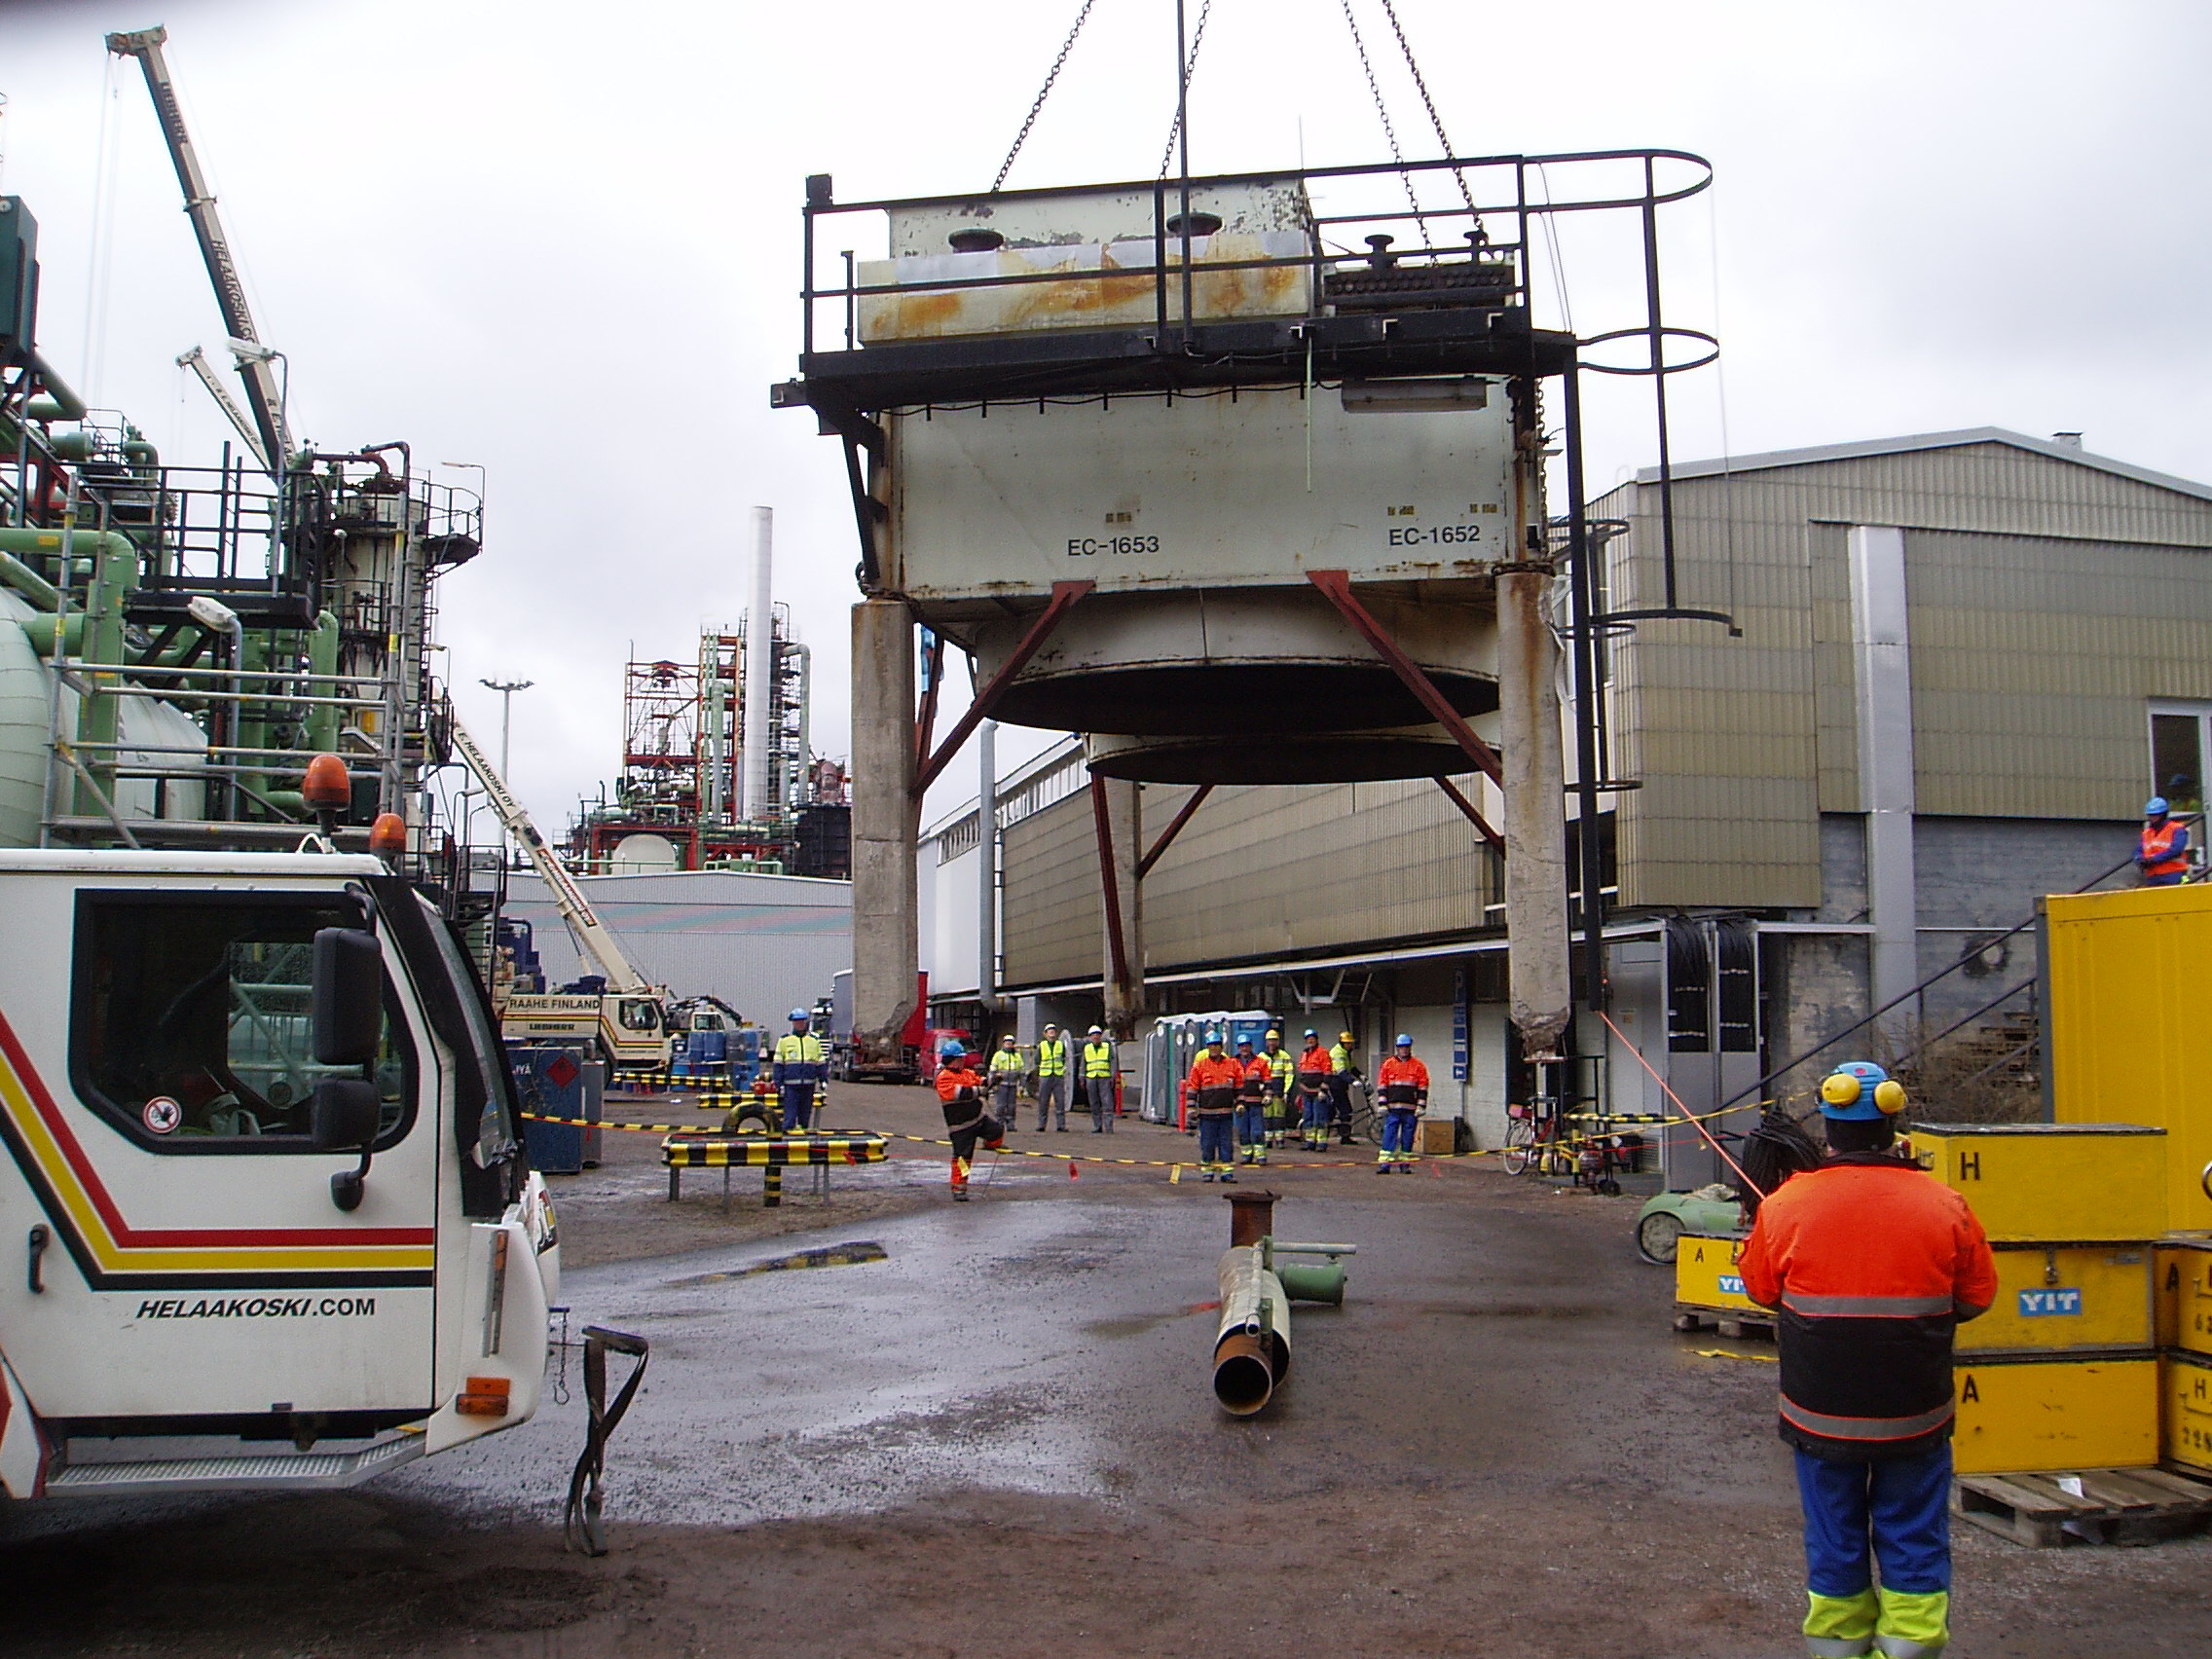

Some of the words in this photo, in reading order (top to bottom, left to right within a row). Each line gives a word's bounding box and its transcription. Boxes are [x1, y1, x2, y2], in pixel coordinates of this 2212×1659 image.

[1068, 536, 1160, 556] EC-1653
[1389, 525, 1480, 546] EC-1652
[465, 740, 505, 799] HELAAKOSKI
[501, 794, 516, 808] OY
[509, 999, 548, 1009] RAAHE
[551, 999, 600, 1009] FINLAND
[1961, 1152, 1980, 1180] H
[1695, 1247, 1705, 1263] A
[2165, 1263, 2180, 1292] A
[136, 1298, 375, 1318] HELAAKOSKI.COM
[2020, 1293, 2079, 1310] YIT
[1962, 1374, 1979, 1403] A
[2194, 1378, 2206, 1399] H
